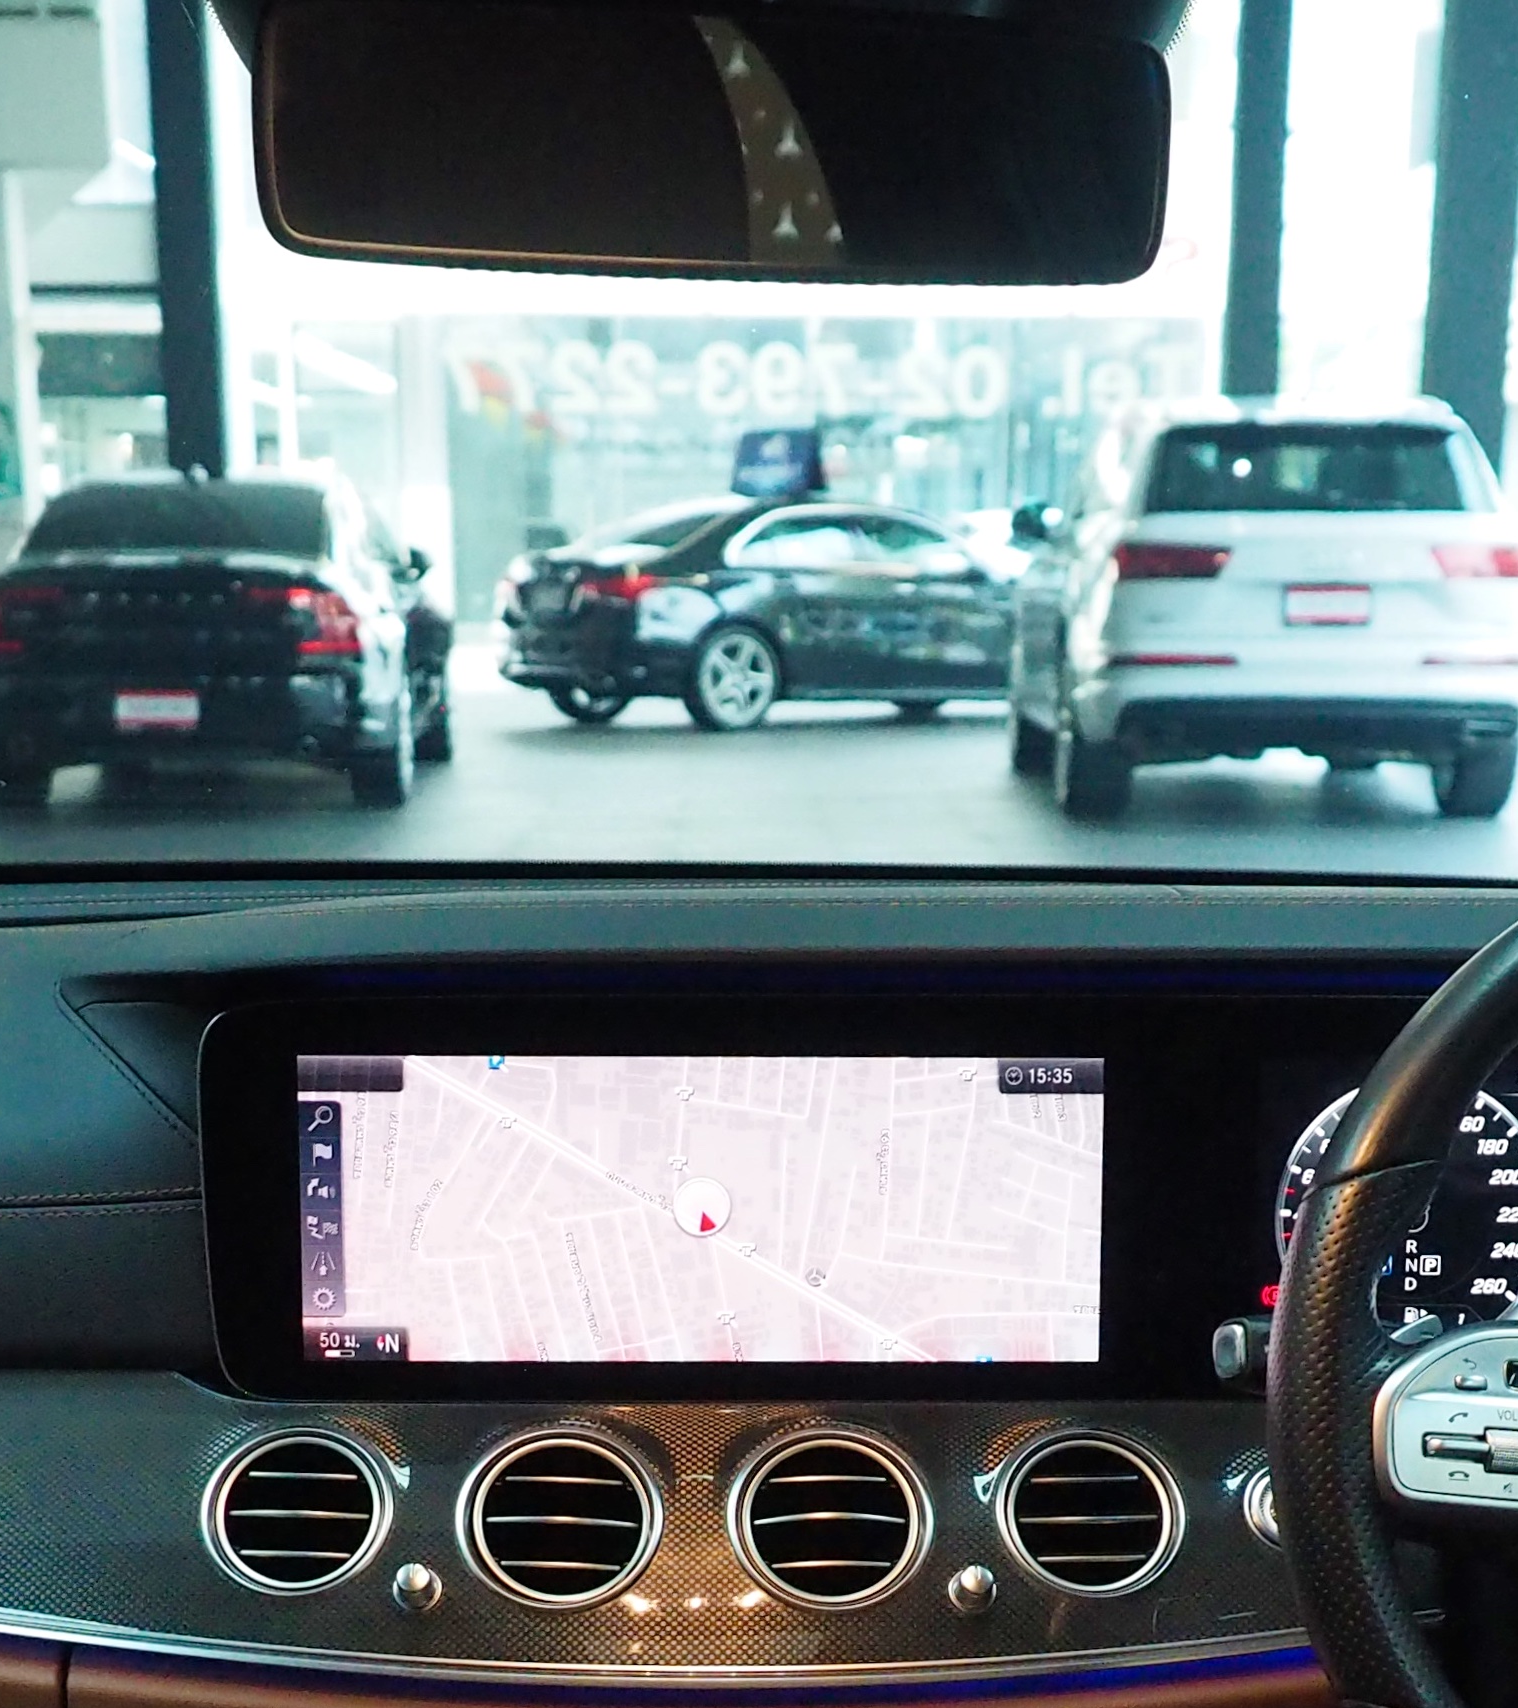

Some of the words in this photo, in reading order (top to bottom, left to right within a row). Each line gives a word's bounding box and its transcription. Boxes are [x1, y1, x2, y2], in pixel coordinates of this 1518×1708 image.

[1028, 1067, 1074, 1085] 15:35
[1458, 1114, 1486, 1133] 60
[1476, 1138, 1510, 1156] 180
[1300, 1167, 1316, 1186] 6
[1405, 1239, 1418, 1254] R
[1404, 1257, 1418, 1273] N
[1423, 1257, 1438, 1273] P
[1403, 1276, 1418, 1292] D
[1469, 1277, 1508, 1295] 260
[319, 1332, 341, 1348] 50
[344, 1334, 361, 1349] ม.
[385, 1332, 400, 1354] N
[1496, 1409, 1518, 1422] VOL
